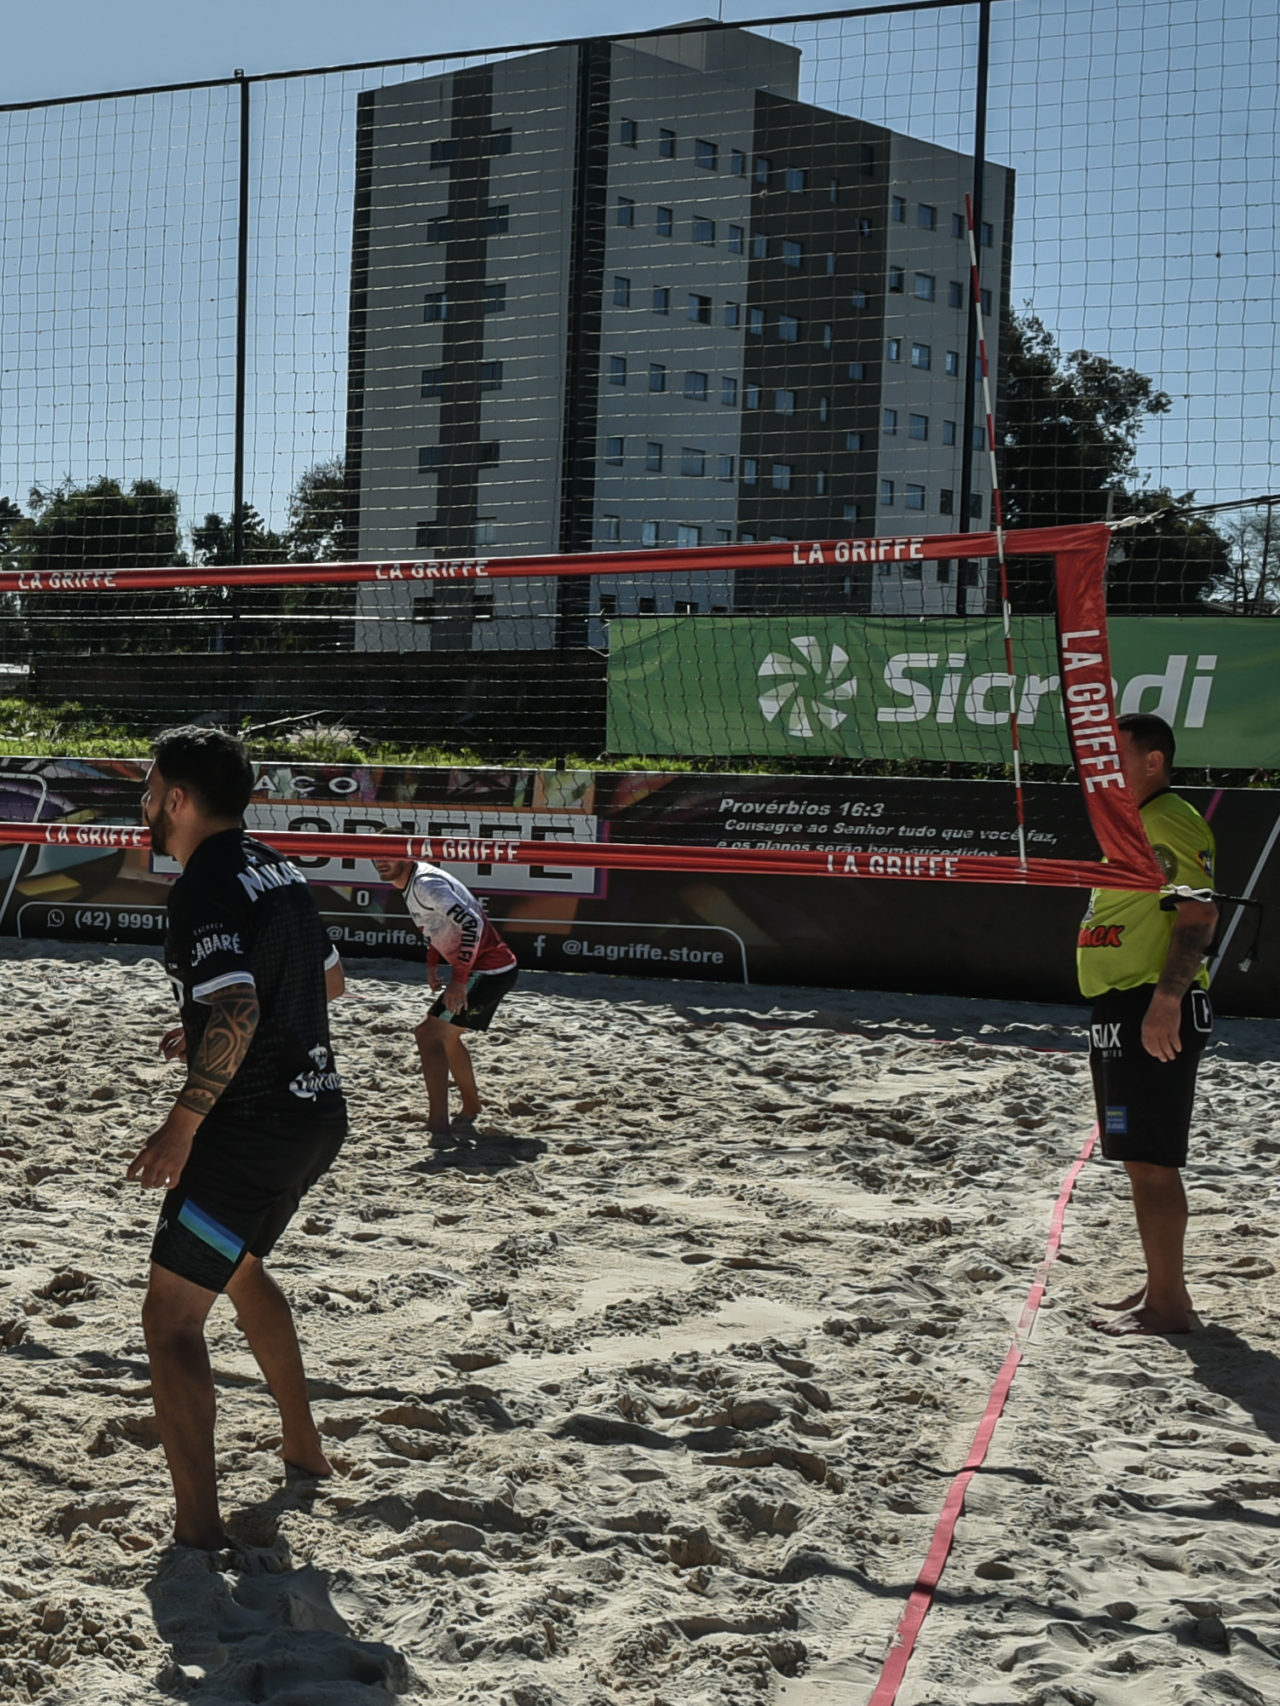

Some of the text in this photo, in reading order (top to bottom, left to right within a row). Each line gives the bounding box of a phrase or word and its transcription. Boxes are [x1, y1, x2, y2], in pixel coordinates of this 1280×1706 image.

[792, 538, 924, 565] LA GRIFFE
[18, 571, 116, 591] LA GRIFFE
[375, 560, 488, 580] LA GRIFFE
[876, 653, 1218, 728] Sicrdi
[1061, 629, 1127, 793] LA GRIFFE
[718, 798, 885, 817] Provérbios 16:3
[45, 825, 145, 847] LA GRIFFE
[724, 819, 1058, 845] Consagre ao Senhor tudo que você faz,
[406, 838, 520, 862] LA GRIFFE
[717, 840, 727, 849] e
[731, 841, 750, 850] os
[827, 854, 959, 878] LA GRIFFE
[75, 910, 170, 930] (42) 9991
[562, 939, 724, 964] @Lagriffe.store
